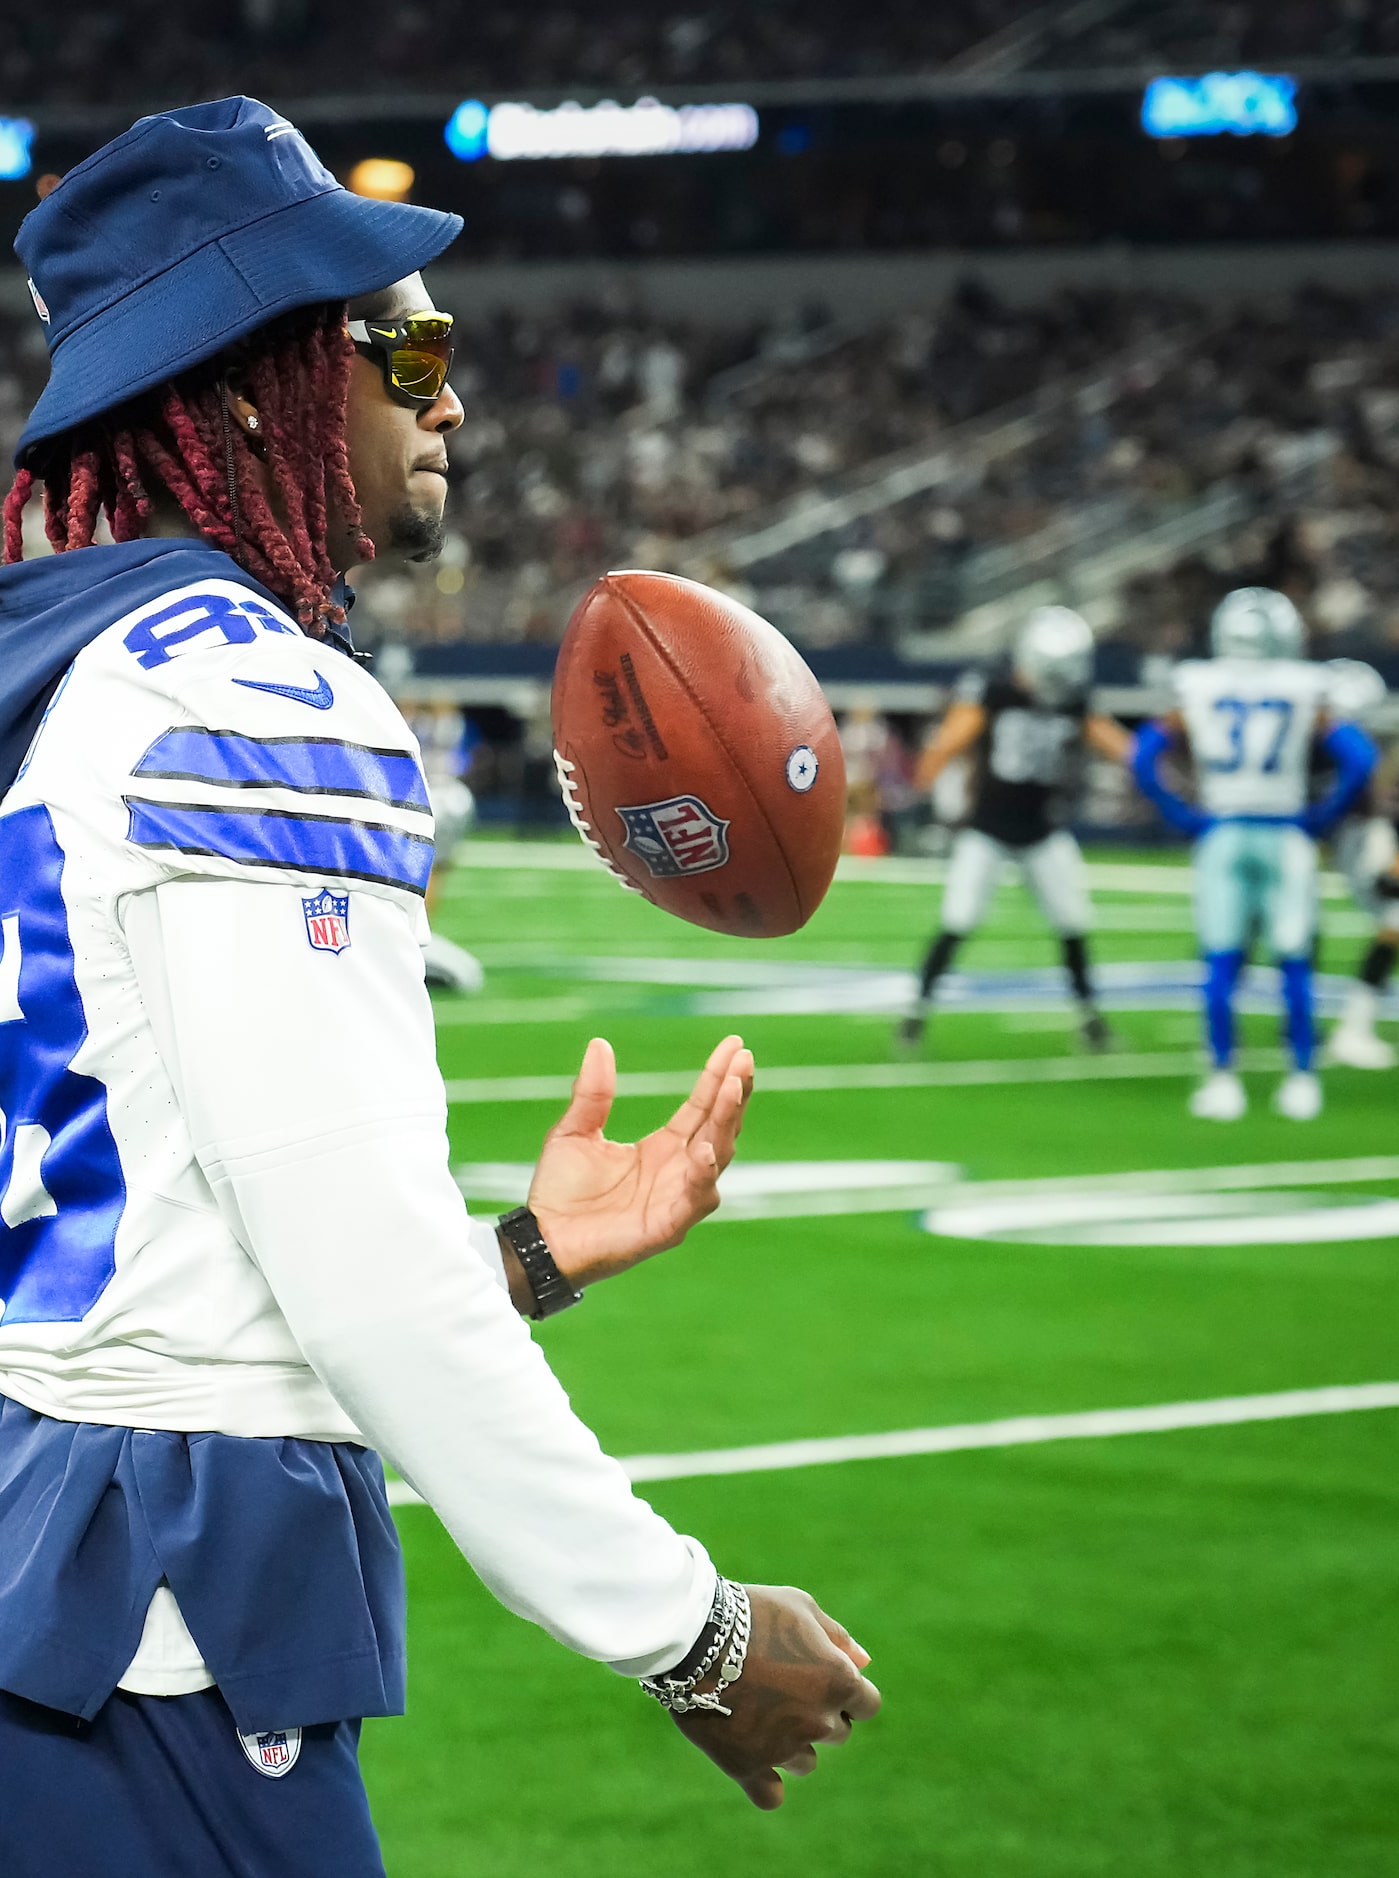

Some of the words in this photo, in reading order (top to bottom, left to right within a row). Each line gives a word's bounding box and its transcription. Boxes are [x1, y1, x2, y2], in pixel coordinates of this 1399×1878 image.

[1209, 696, 1295, 774] 37
[658, 804, 720, 868] NFL
[263, 1746, 287, 1764] NFL
